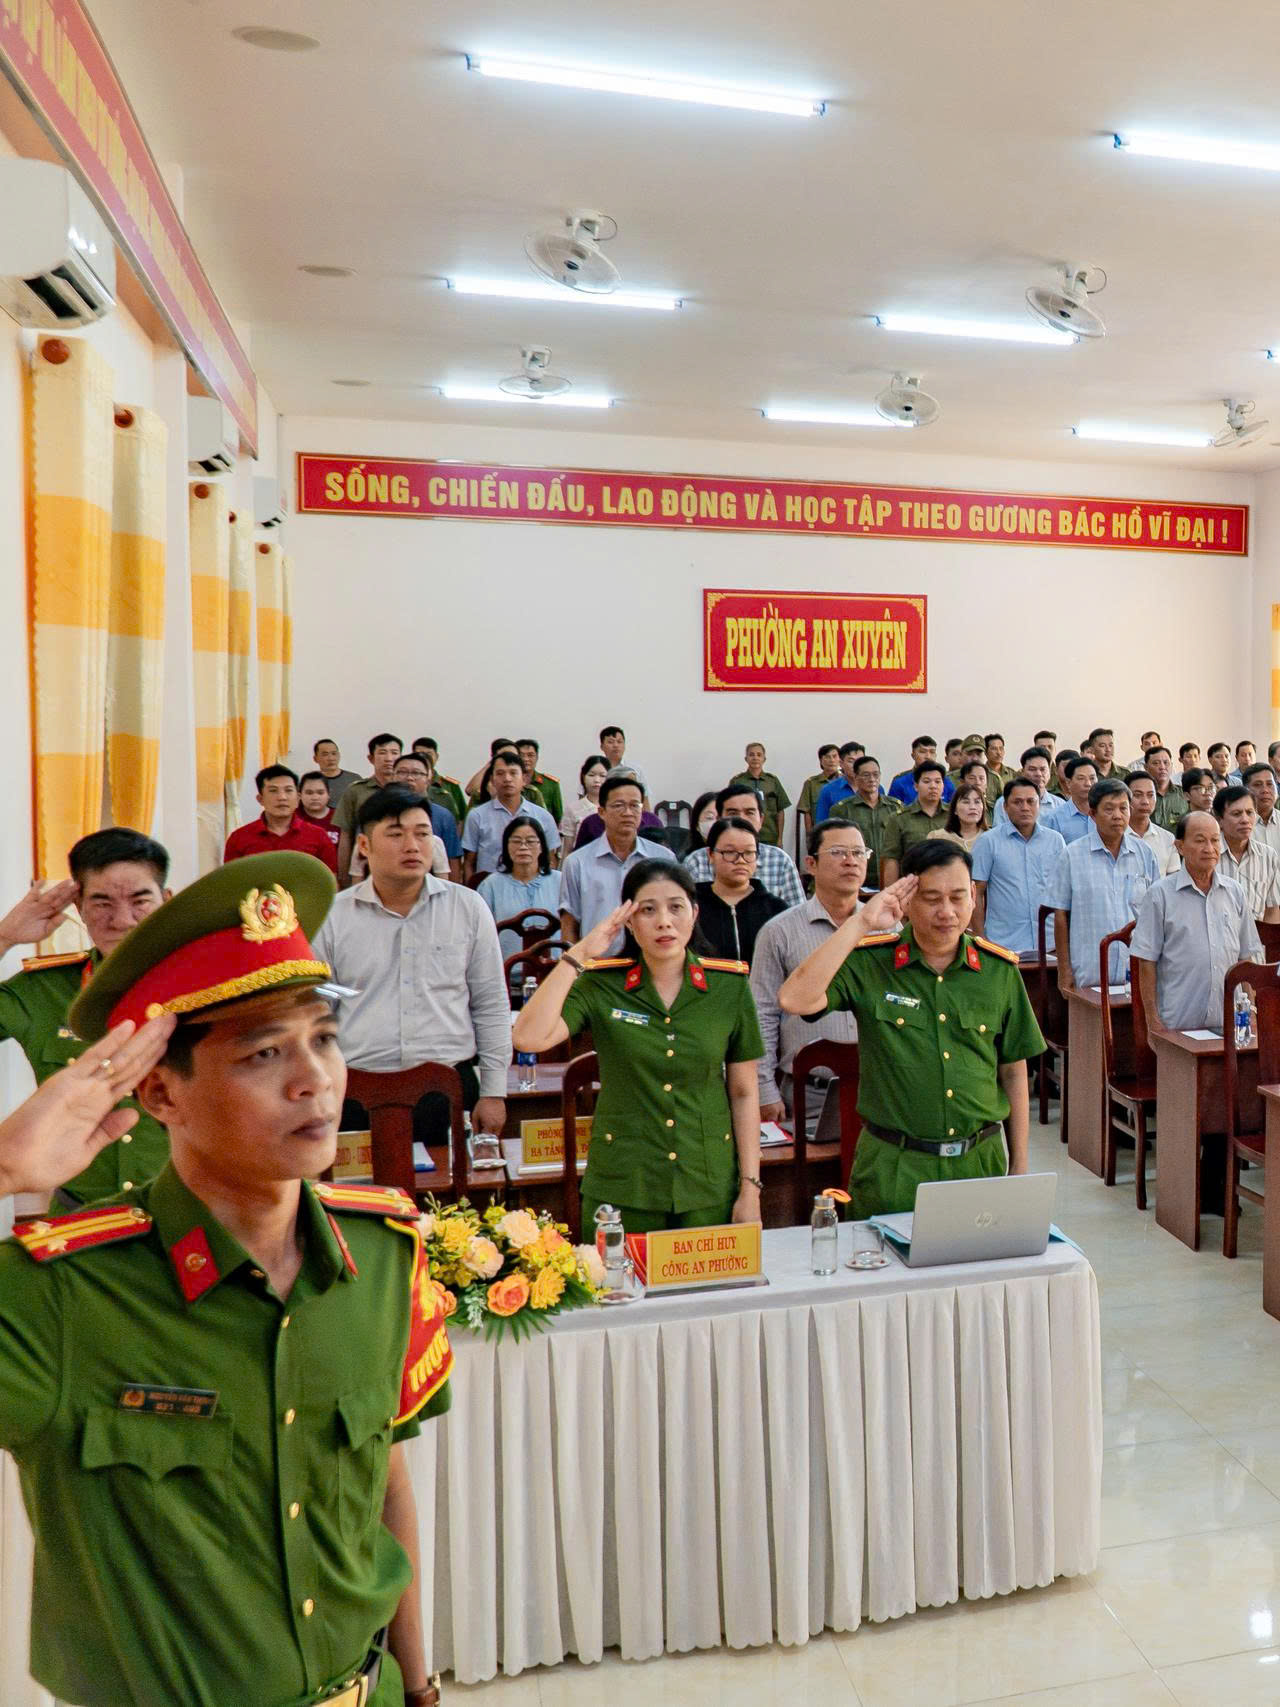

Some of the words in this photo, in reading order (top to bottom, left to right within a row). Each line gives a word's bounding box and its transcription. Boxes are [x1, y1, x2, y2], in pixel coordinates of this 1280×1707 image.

[325, 463, 420, 508] SỐNG,
[429, 471, 519, 510] CHIẾN
[527, 474, 595, 515] ĐẤU,
[602, 486, 654, 516] LAO
[661, 484, 737, 523] ĐỘNG
[744, 487, 779, 521] VÀ
[786, 495, 836, 529] HỌC
[844, 494, 892, 531] TẬP
[899, 502, 962, 531] THEO
[968, 504, 1052, 536] GƯƠNG
[1058, 505, 1106, 538] BÁC
[1112, 506, 1143, 540] HỒ
[1148, 512, 1171, 541] VĨ
[1176, 517, 1215, 548] ĐẠI
[1222, 518, 1229, 544] !
[725, 602, 808, 668] PHƯỜNG
[810, 618, 839, 669] AN
[842, 607, 908, 670] XUYÊN
[662, 1260, 689, 1278] CÔNG
[692, 1260, 705, 1275] AN
[708, 1254, 748, 1273] PHƯỜNG
[673, 1240, 694, 1255] BAN
[717, 1236, 737, 1250] HUY
